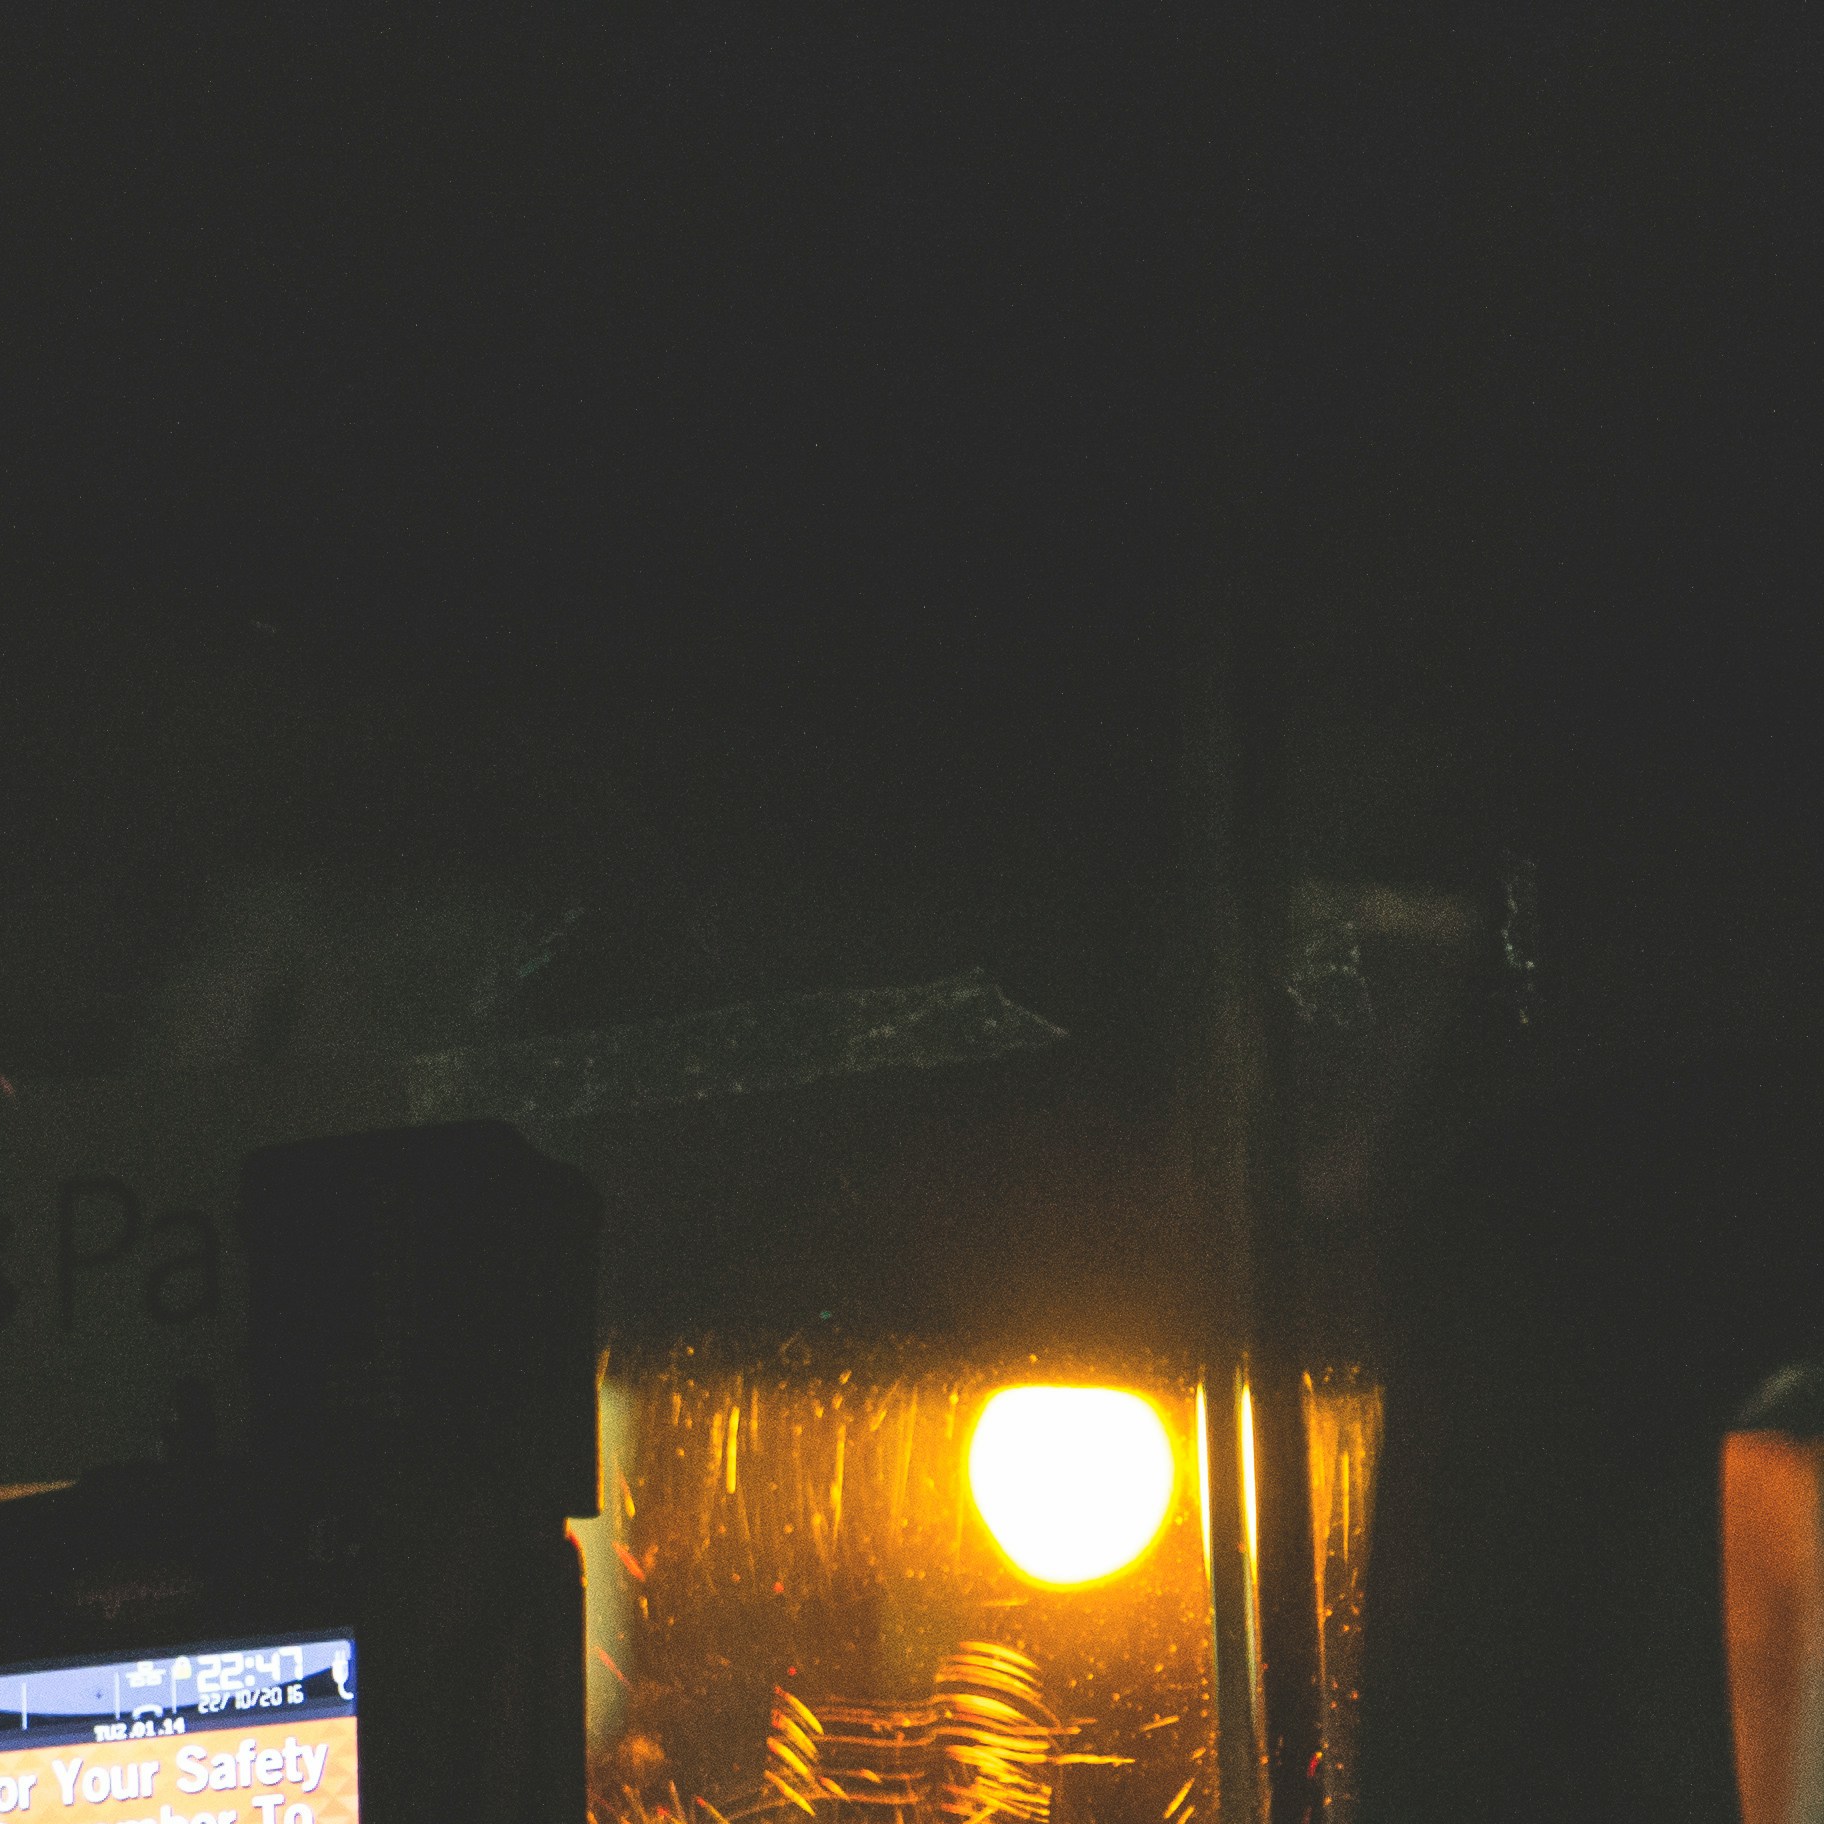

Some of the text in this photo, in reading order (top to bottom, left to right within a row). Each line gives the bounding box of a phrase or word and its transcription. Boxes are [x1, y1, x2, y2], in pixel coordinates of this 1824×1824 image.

[56, 1176, 225, 1334] Pa
[196, 1644, 304, 1694] 22:47
[50, 1755, 159, 1808] Your
[175, 1736, 329, 1796] Safety
